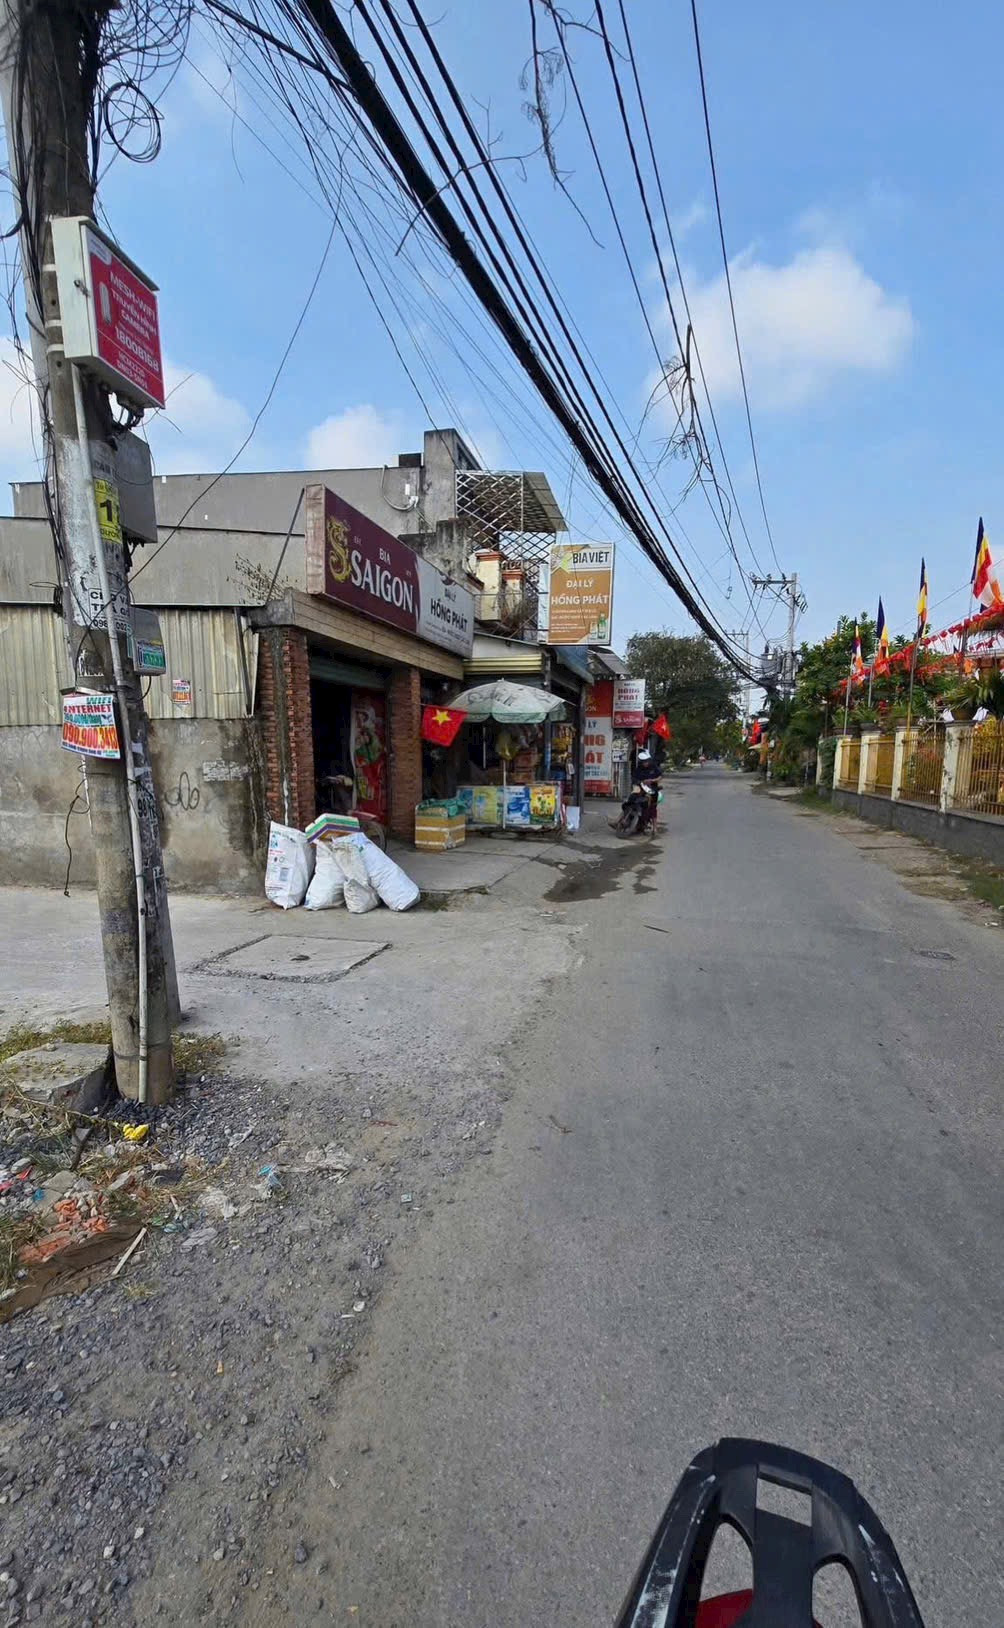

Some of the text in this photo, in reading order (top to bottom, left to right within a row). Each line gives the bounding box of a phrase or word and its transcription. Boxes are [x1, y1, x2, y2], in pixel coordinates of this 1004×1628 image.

[379, 547, 391, 565] BIA
[573, 552, 588, 564] BIA
[351, 549, 413, 613] SAIGON
[583, 577, 594, 588] LÝ
[582, 592, 609, 604] PHÁT
[452, 613, 468, 632] PHÁT
[64, 704, 112, 714] INTERNET
